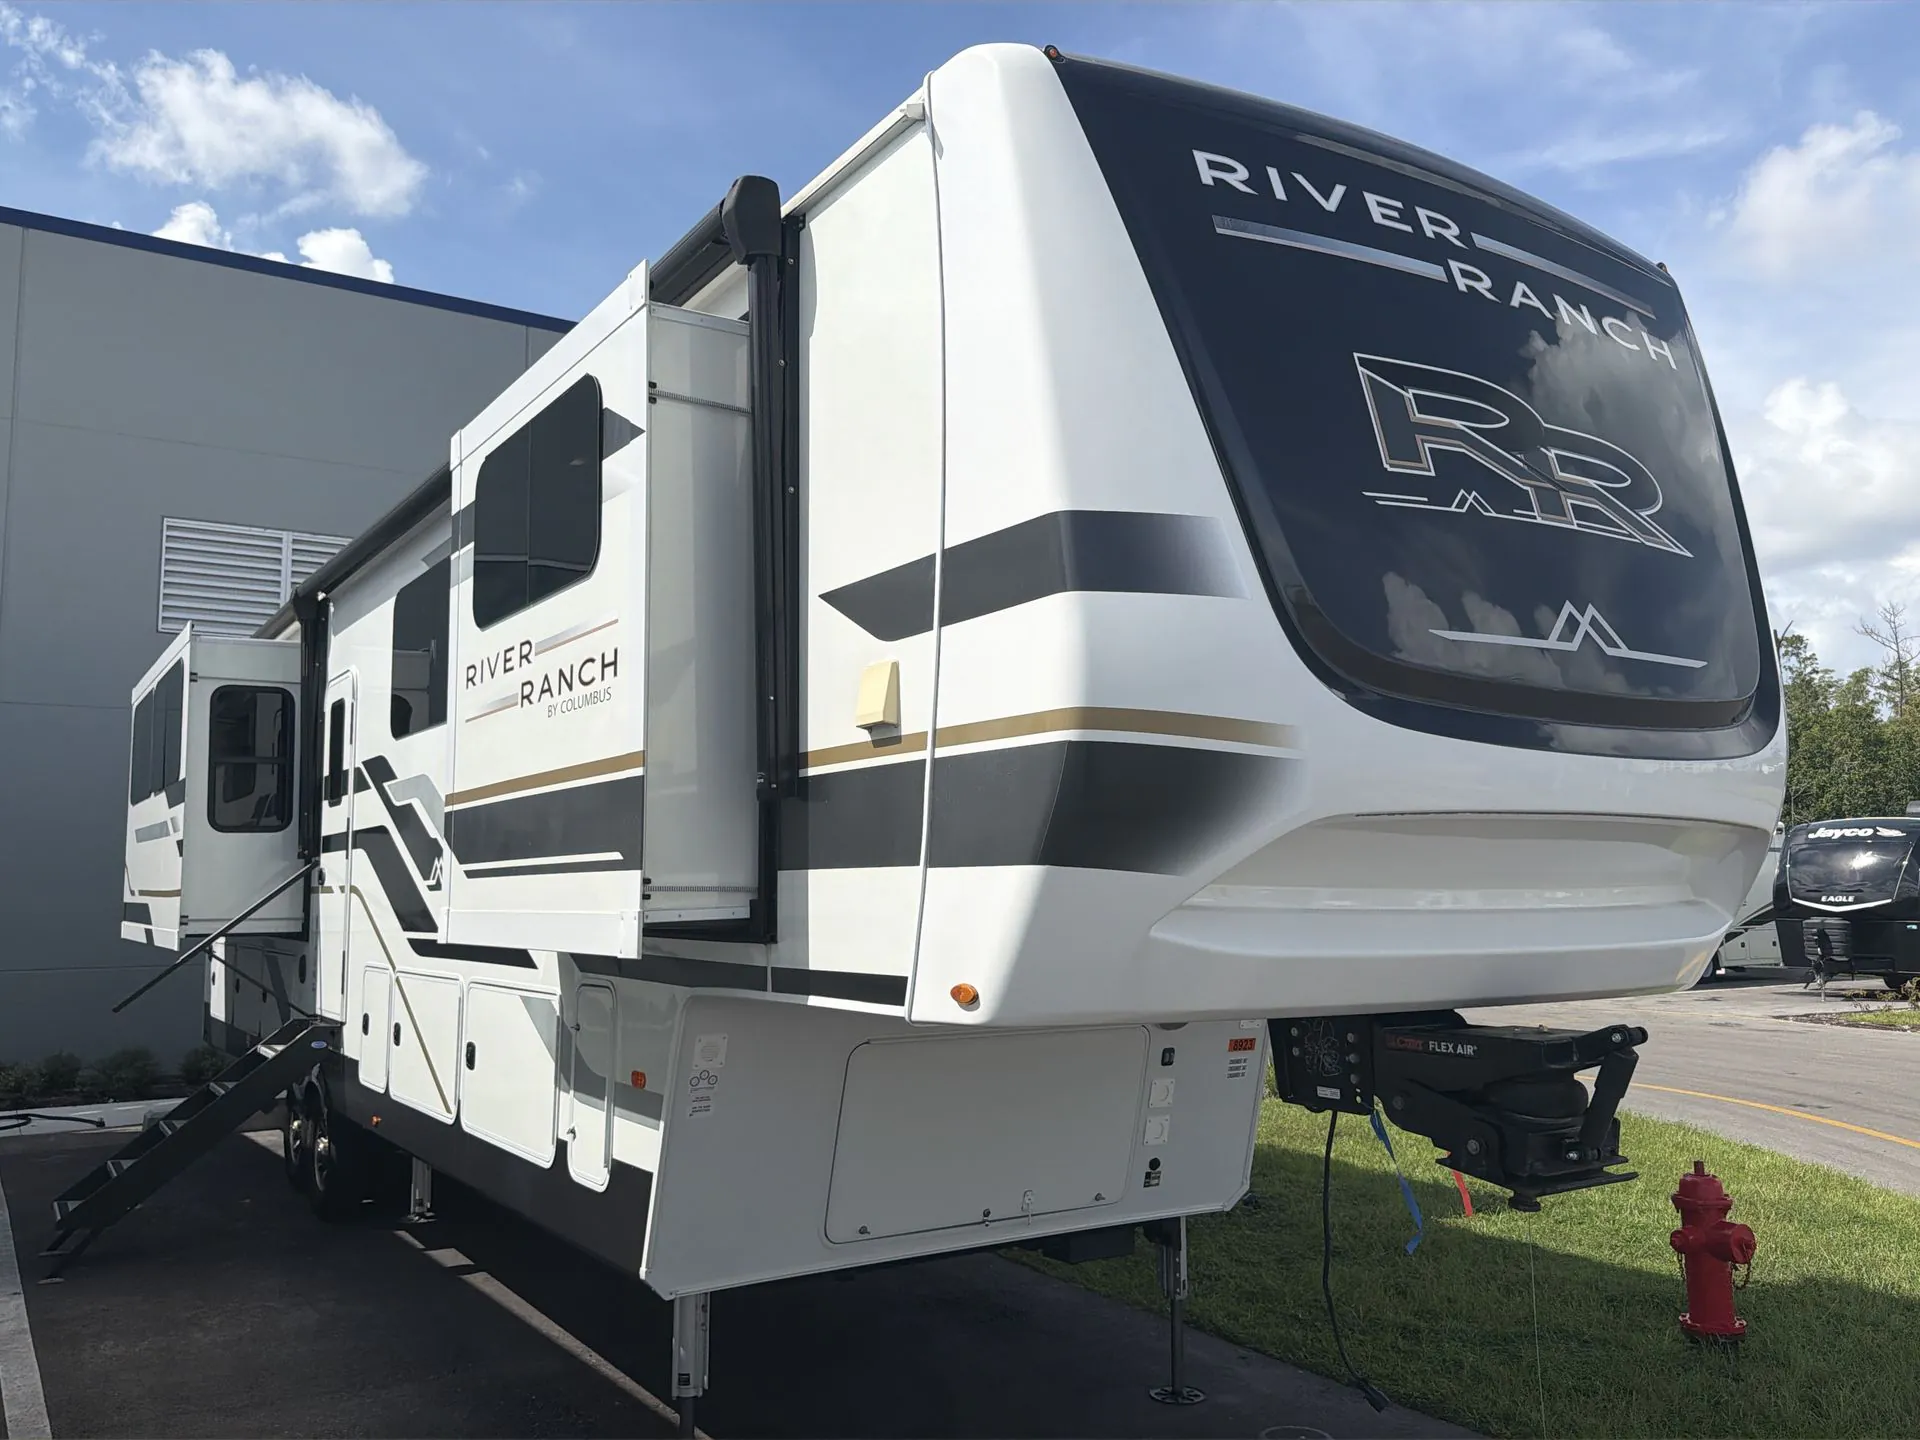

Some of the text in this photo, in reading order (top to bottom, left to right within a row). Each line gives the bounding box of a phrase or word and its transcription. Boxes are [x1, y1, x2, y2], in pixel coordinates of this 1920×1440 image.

[1192, 149, 1469, 249] RIVER
[1447, 259, 1679, 370] RANCH
[466, 639, 533, 690] RIVER
[520, 647, 618, 707] RANCH
[547, 686, 612, 718] BY COLUMBUS
[1808, 827, 1874, 839] Jayco
[1821, 895, 1855, 903] EAGLE
[1428, 1040, 1455, 1054] FLEX
